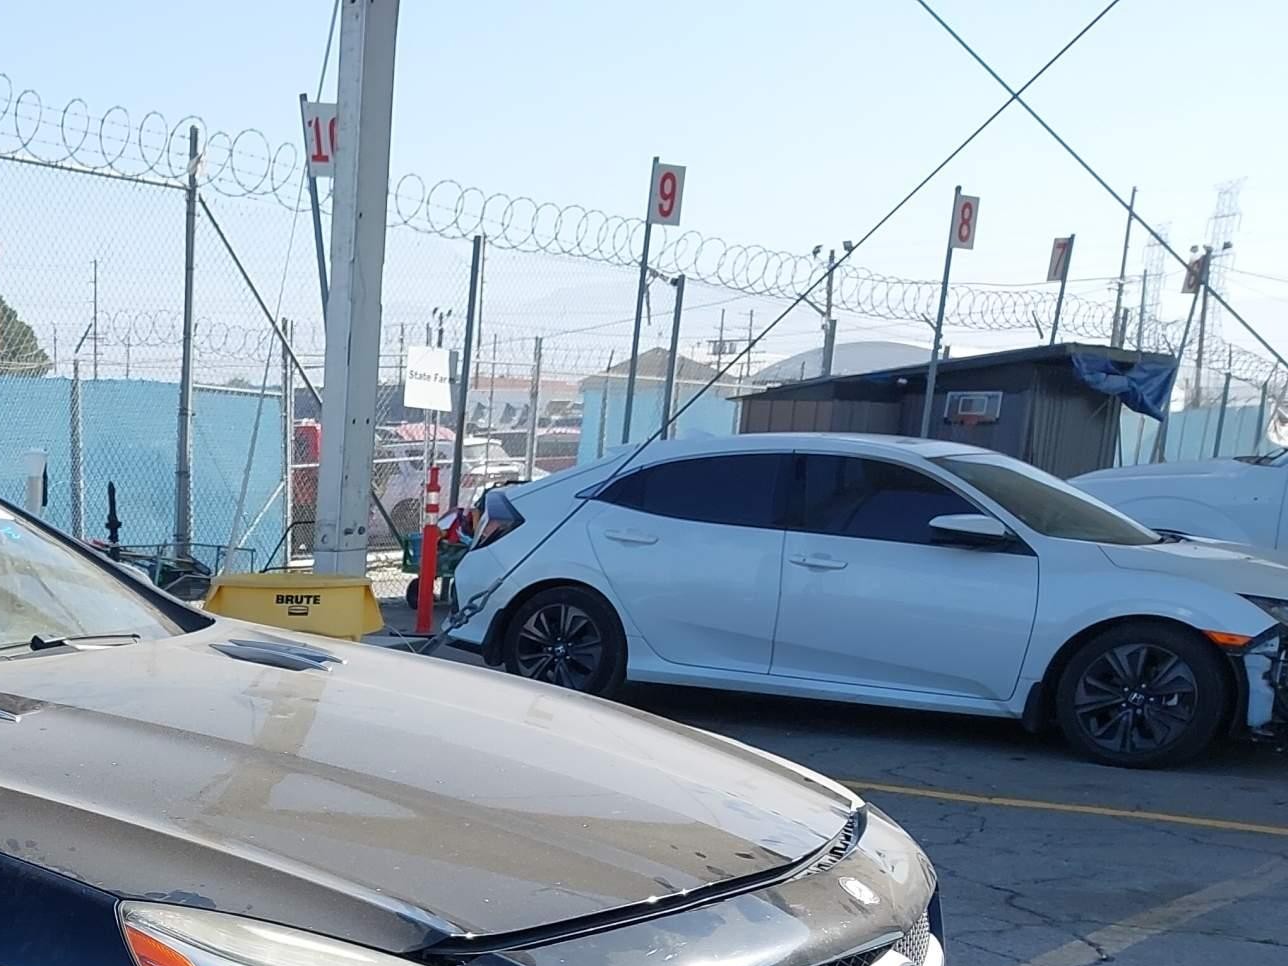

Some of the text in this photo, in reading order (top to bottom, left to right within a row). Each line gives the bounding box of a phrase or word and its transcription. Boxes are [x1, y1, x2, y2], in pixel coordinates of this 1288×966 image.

[658, 171, 677, 218] 9
[958, 201, 973, 243] 8
[409, 369, 431, 382] State
[275, 594, 321, 605] BRUTE
